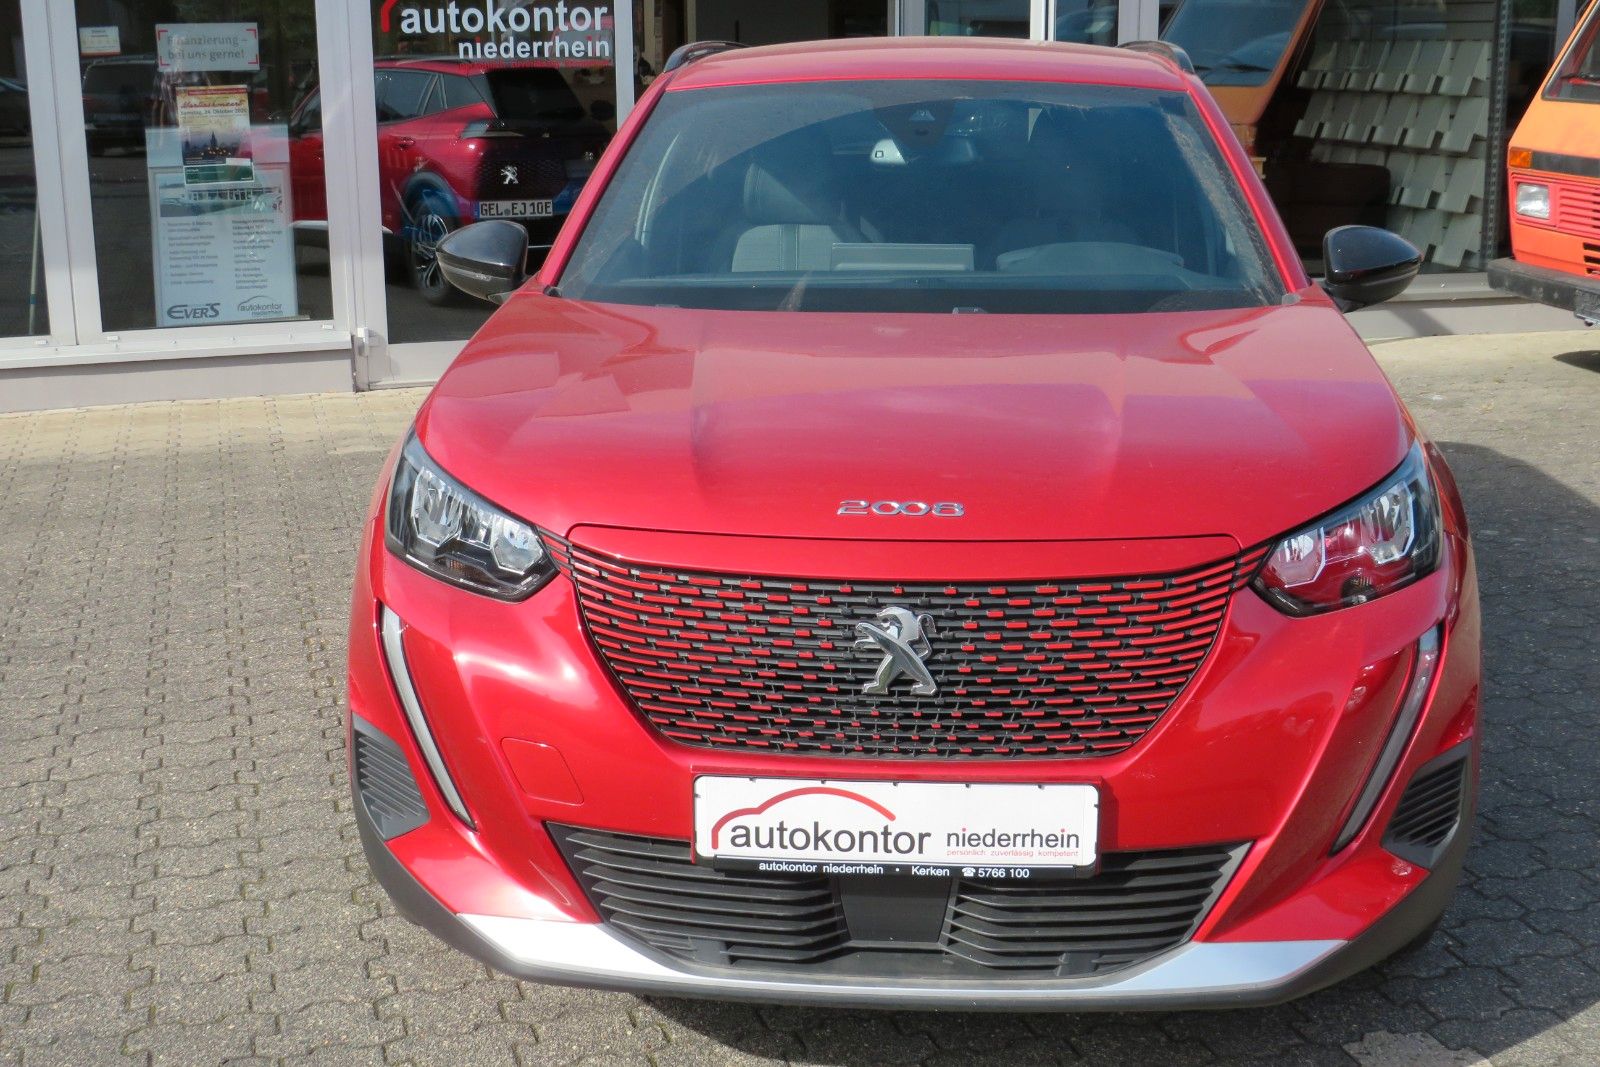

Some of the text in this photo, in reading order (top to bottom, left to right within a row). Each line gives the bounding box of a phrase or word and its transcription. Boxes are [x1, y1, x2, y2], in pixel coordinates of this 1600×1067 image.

[400, 0, 608, 34] autokontor
[458, 36, 610, 59] niederrhein
[480, 201, 552, 217] GEL EJ 10E
[837, 500, 965, 517] 2008
[730, 821, 1080, 854] autokontor niederrhein
[1037, 849, 1079, 858] kompetent
[758, 861, 1030, 878] autokontor niederrhein Kerken 5766 100
